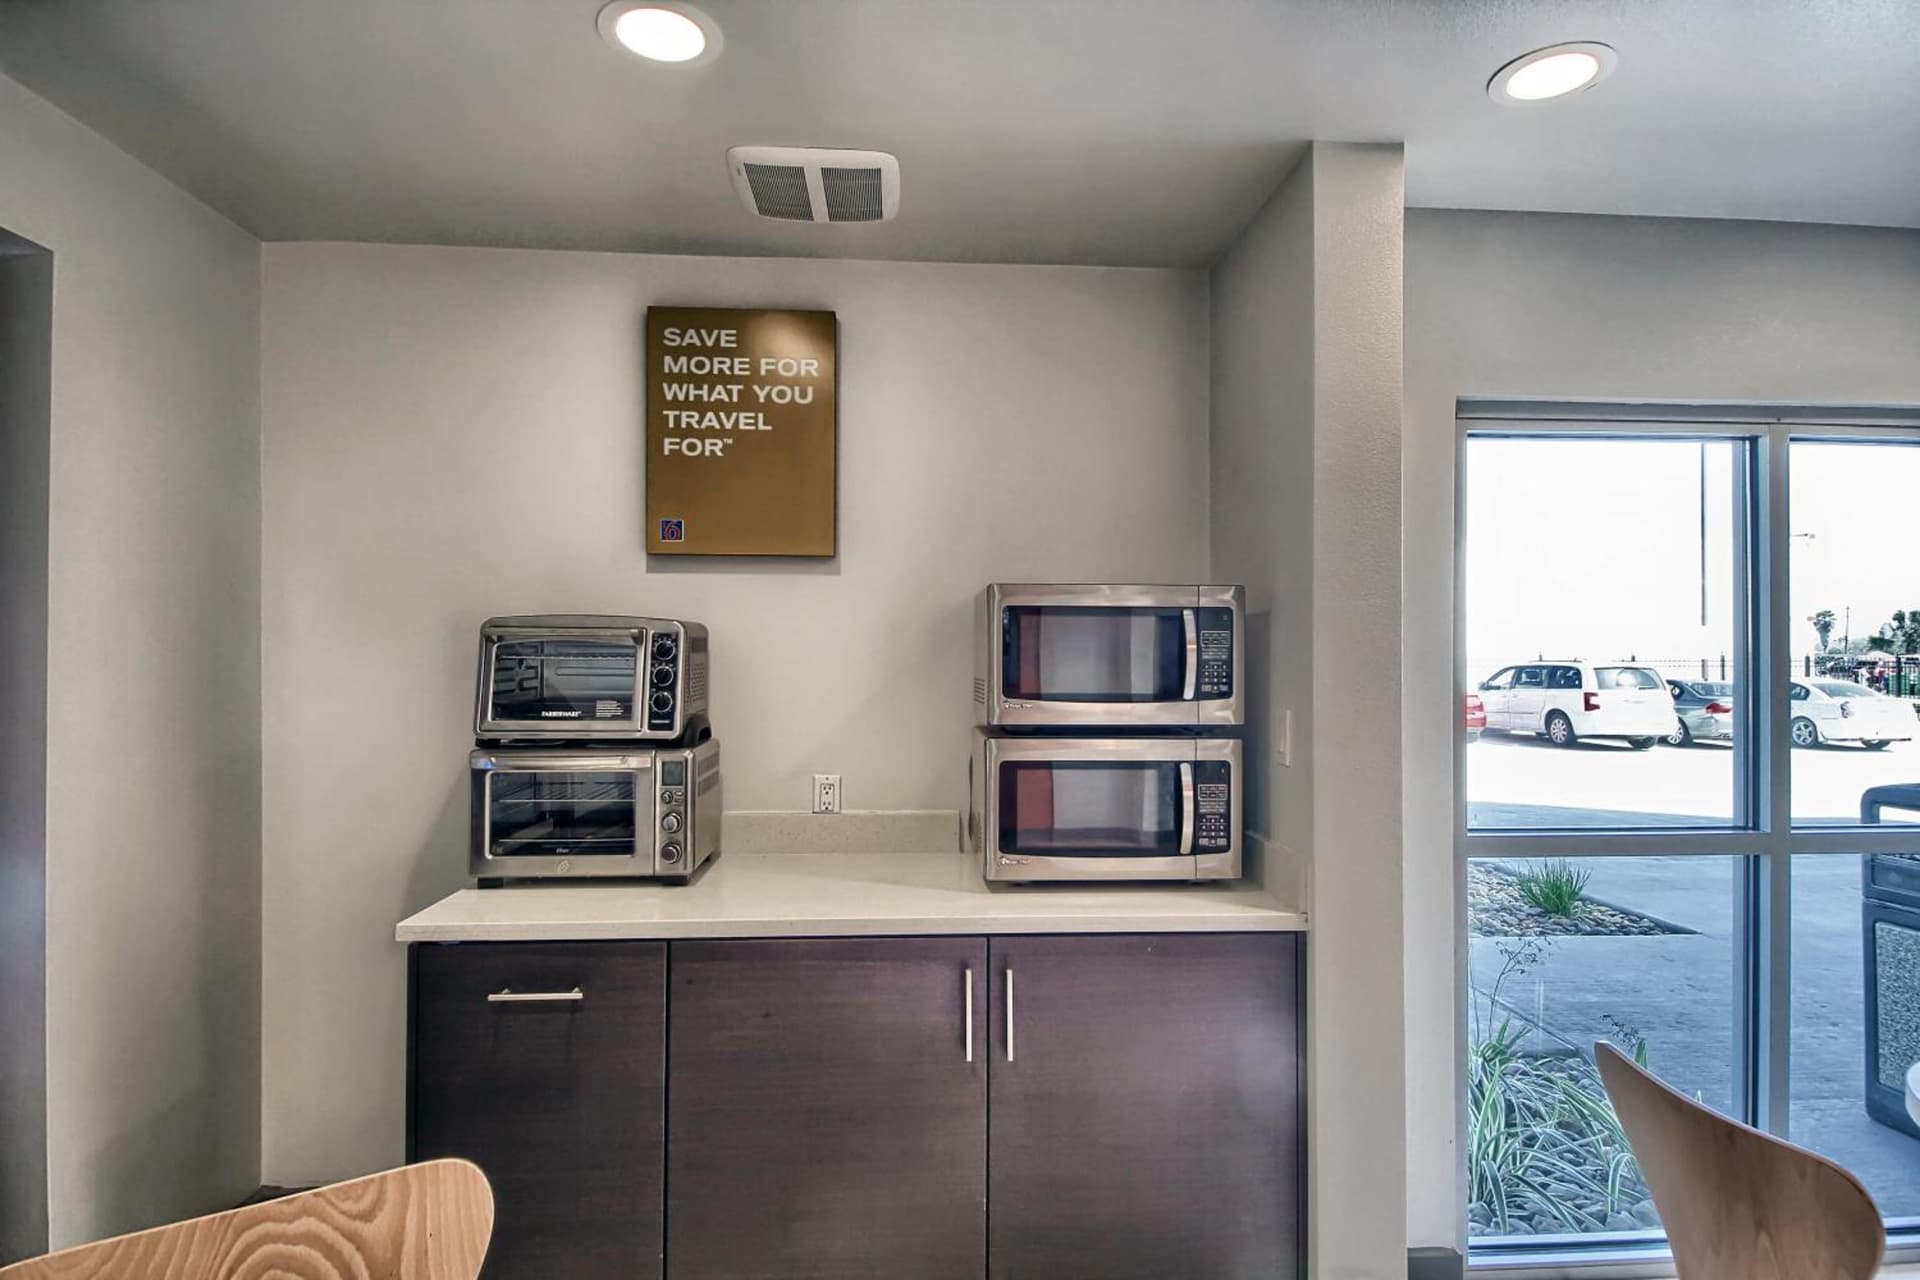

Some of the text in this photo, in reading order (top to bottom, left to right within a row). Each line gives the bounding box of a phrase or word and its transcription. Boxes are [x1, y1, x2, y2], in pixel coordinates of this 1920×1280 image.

[663, 327, 737, 348] SAVE
[663, 355, 819, 377] MORE FOR
[662, 382, 814, 404] WHAT YOU
[663, 410, 772, 430] TRAVEL
